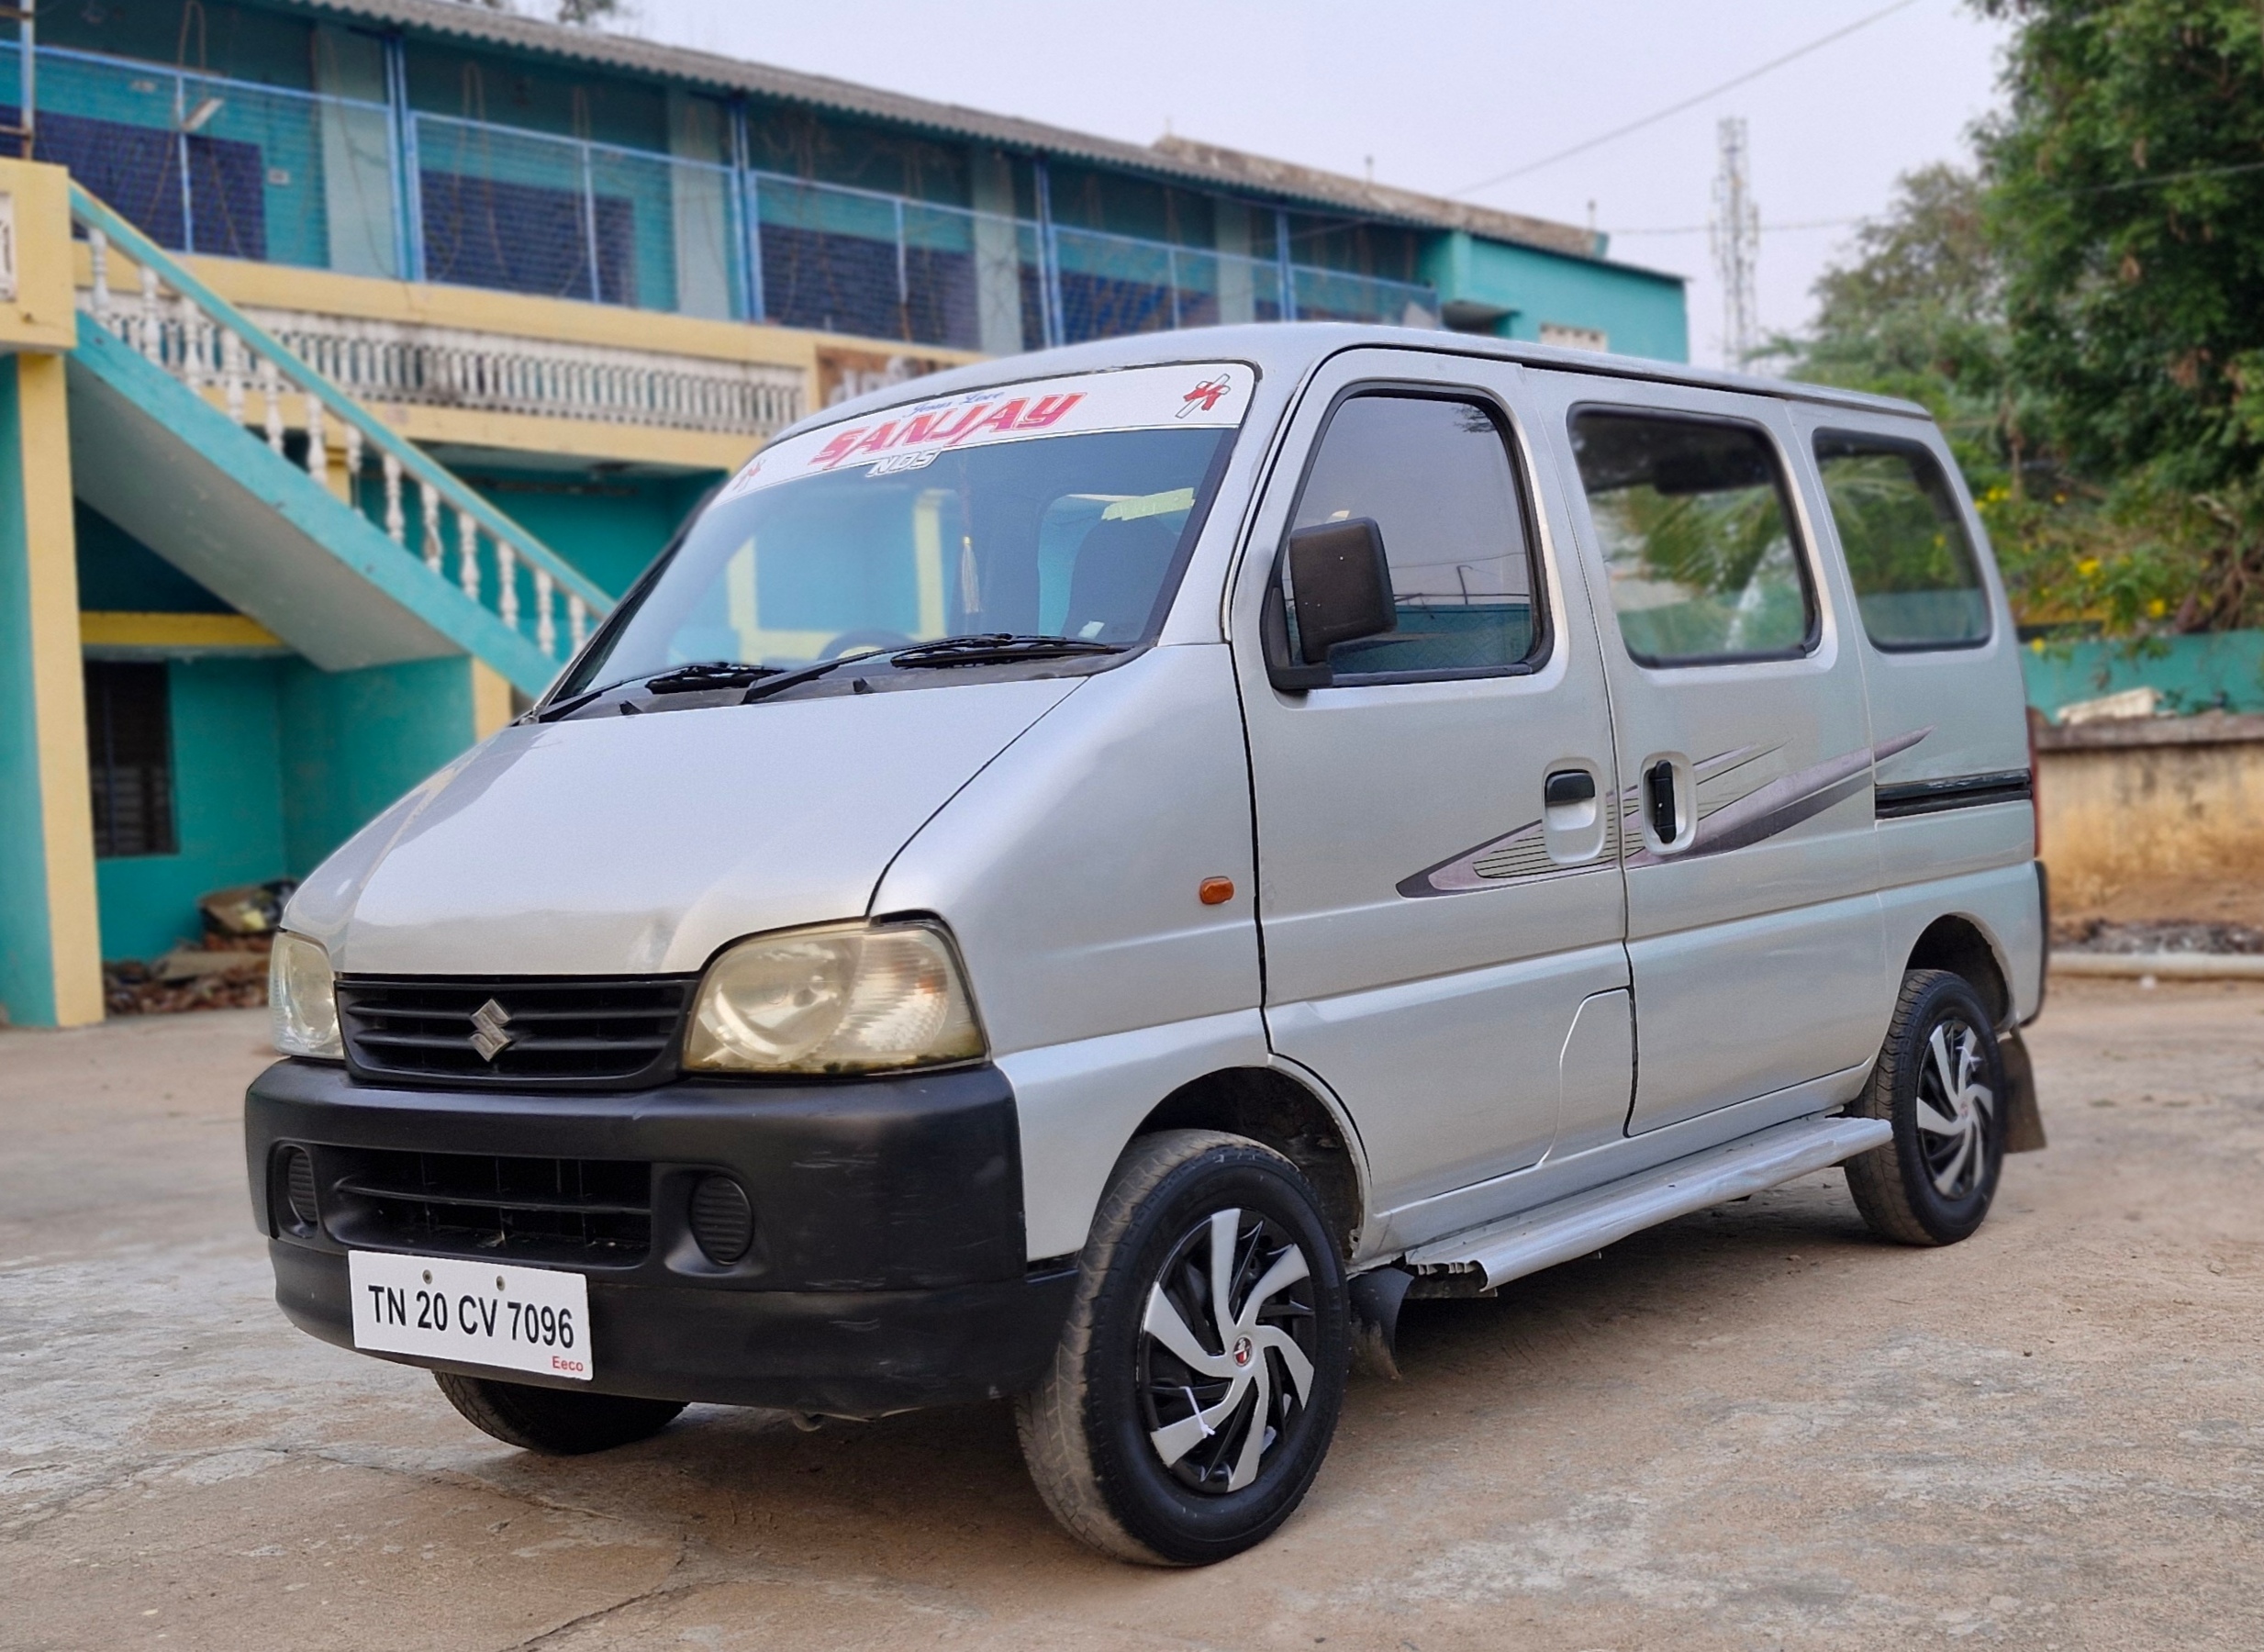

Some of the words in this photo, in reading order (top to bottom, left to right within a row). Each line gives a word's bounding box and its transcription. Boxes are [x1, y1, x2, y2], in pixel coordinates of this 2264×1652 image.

[809, 392, 1087, 470] SANJAY
[368, 1285, 407, 1326] TN
[416, 1290, 448, 1332] 20
[459, 1295, 497, 1337] CV
[507, 1301, 574, 1349] 7096
[552, 1356, 584, 1372] Eeco
